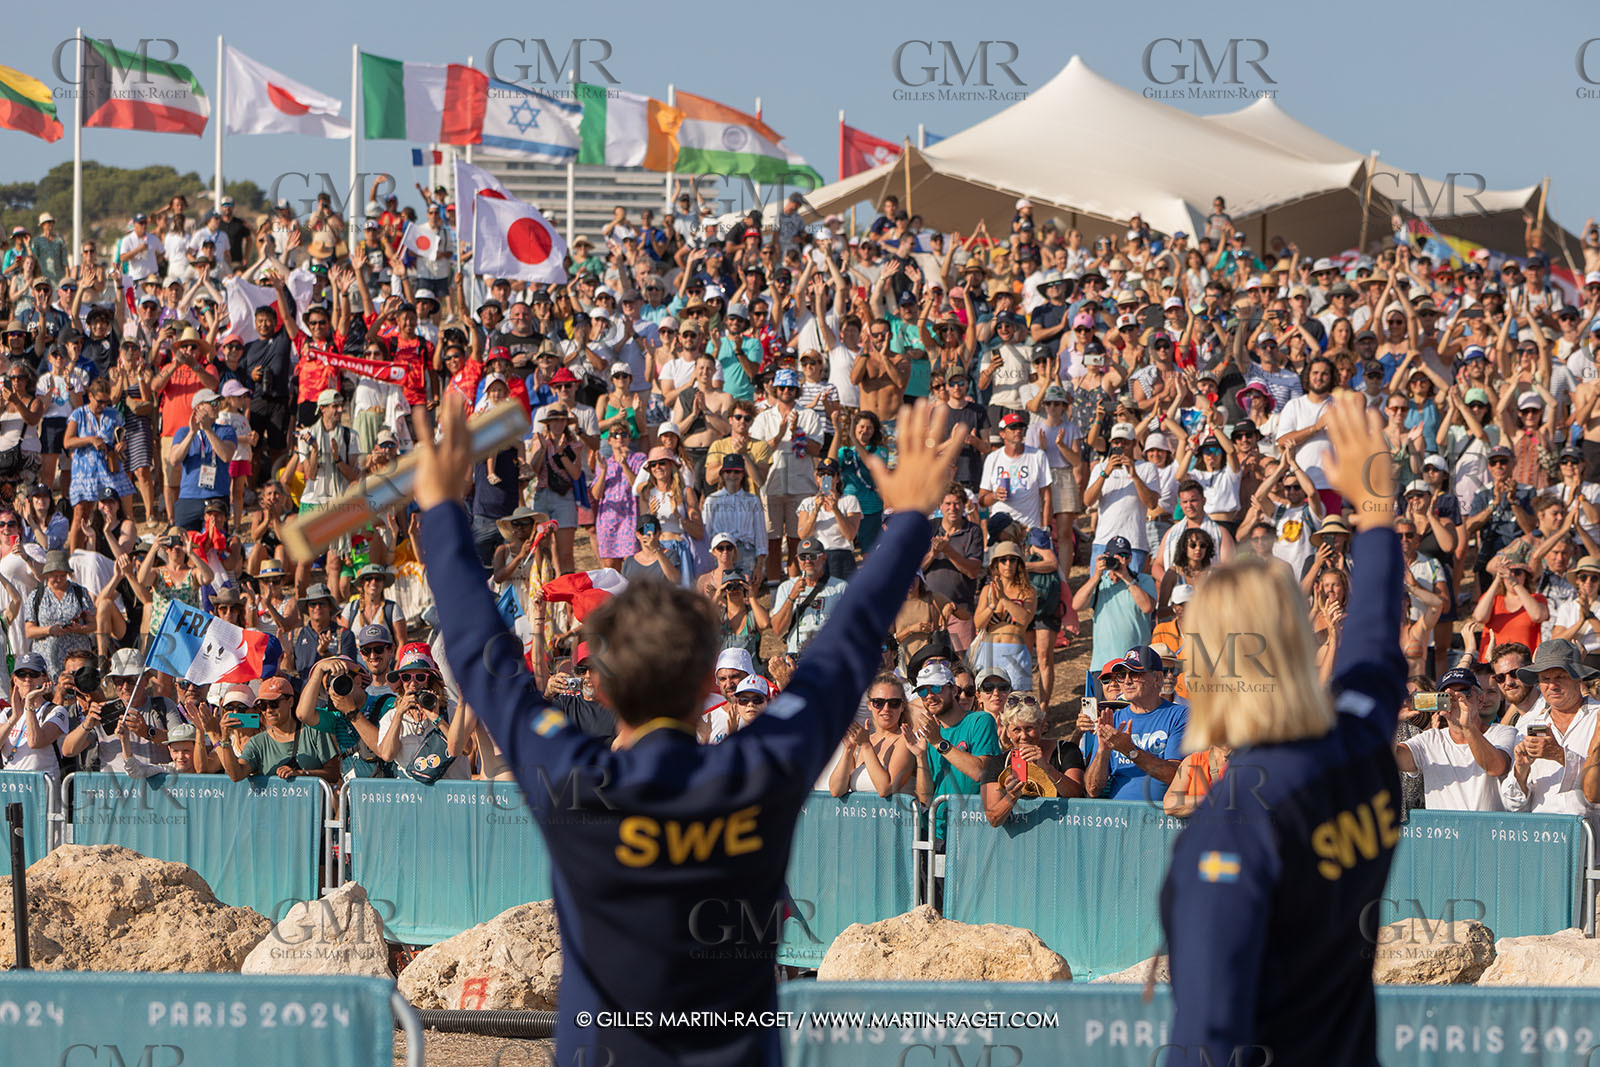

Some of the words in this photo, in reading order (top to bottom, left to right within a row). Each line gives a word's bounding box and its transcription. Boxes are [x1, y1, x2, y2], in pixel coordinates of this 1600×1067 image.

[330, 358, 374, 374] JAPAN
[1, 783, 33, 793] 2024
[167, 788, 196, 798] PARIS
[198, 788, 225, 799] 2024
[247, 787, 278, 798] PARIS
[281, 786, 309, 797] 2024
[361, 793, 392, 803] PARIS
[395, 793, 423, 803] 2024
[447, 794, 477, 804] PARIS
[480, 794, 509, 805] 2024
[835, 806, 867, 818] PARIS
[871, 807, 901, 819] 2024
[1058, 814, 1094, 827] PARIS
[1096, 815, 1128, 828] 2024
[615, 806, 763, 868] SWE
[1311, 790, 1400, 881] SWE
[1426, 827, 1459, 840] 2024
[1491, 829, 1529, 842] PARIS
[1533, 831, 1567, 844] 2024
[147, 1001, 248, 1028] PARIS
[260, 1001, 350, 1028] 2024
[1085, 1019, 1169, 1046] PARI
[1395, 1024, 1505, 1053] PARIS
[1520, 1026, 1600, 1056] 202
